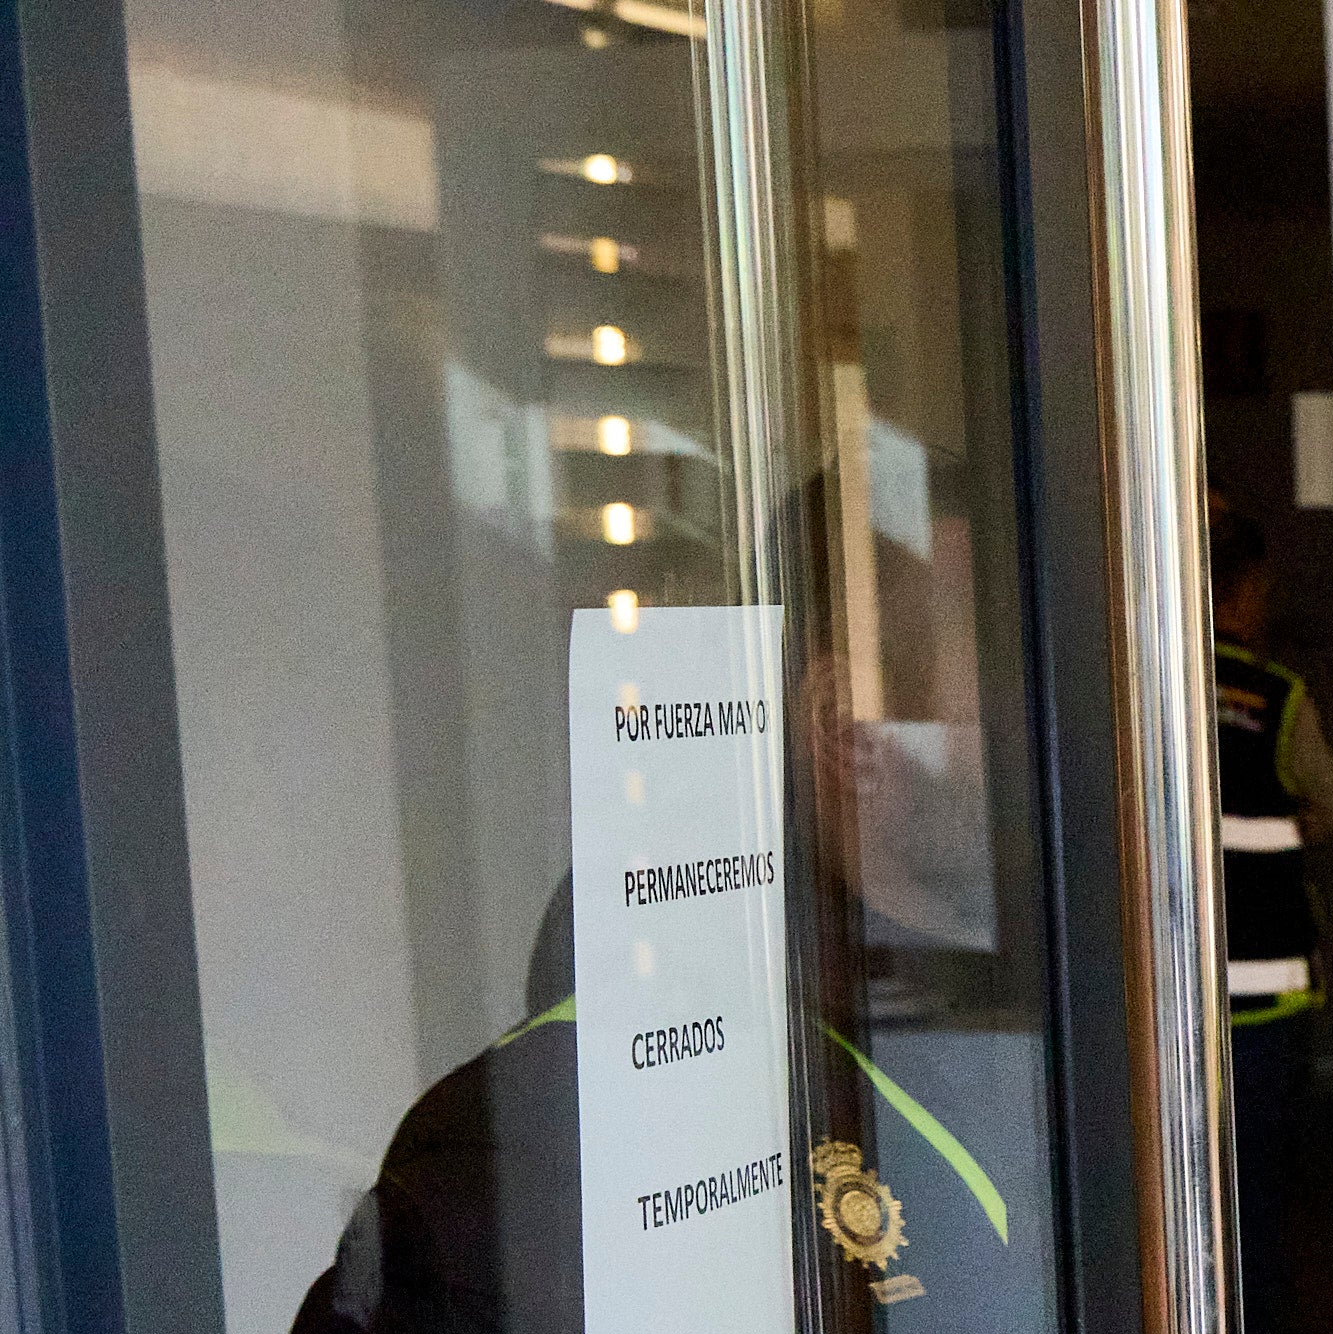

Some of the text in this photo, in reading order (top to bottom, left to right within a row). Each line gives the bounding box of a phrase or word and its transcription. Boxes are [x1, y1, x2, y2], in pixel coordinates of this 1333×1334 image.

[615, 704, 651, 742] POR
[655, 702, 715, 740] FUERZA
[625, 850, 774, 907] PERMANECEREMOS
[631, 1015, 725, 1070] CERRADOS
[637, 1152, 784, 1231] TEMPORALMENTE
